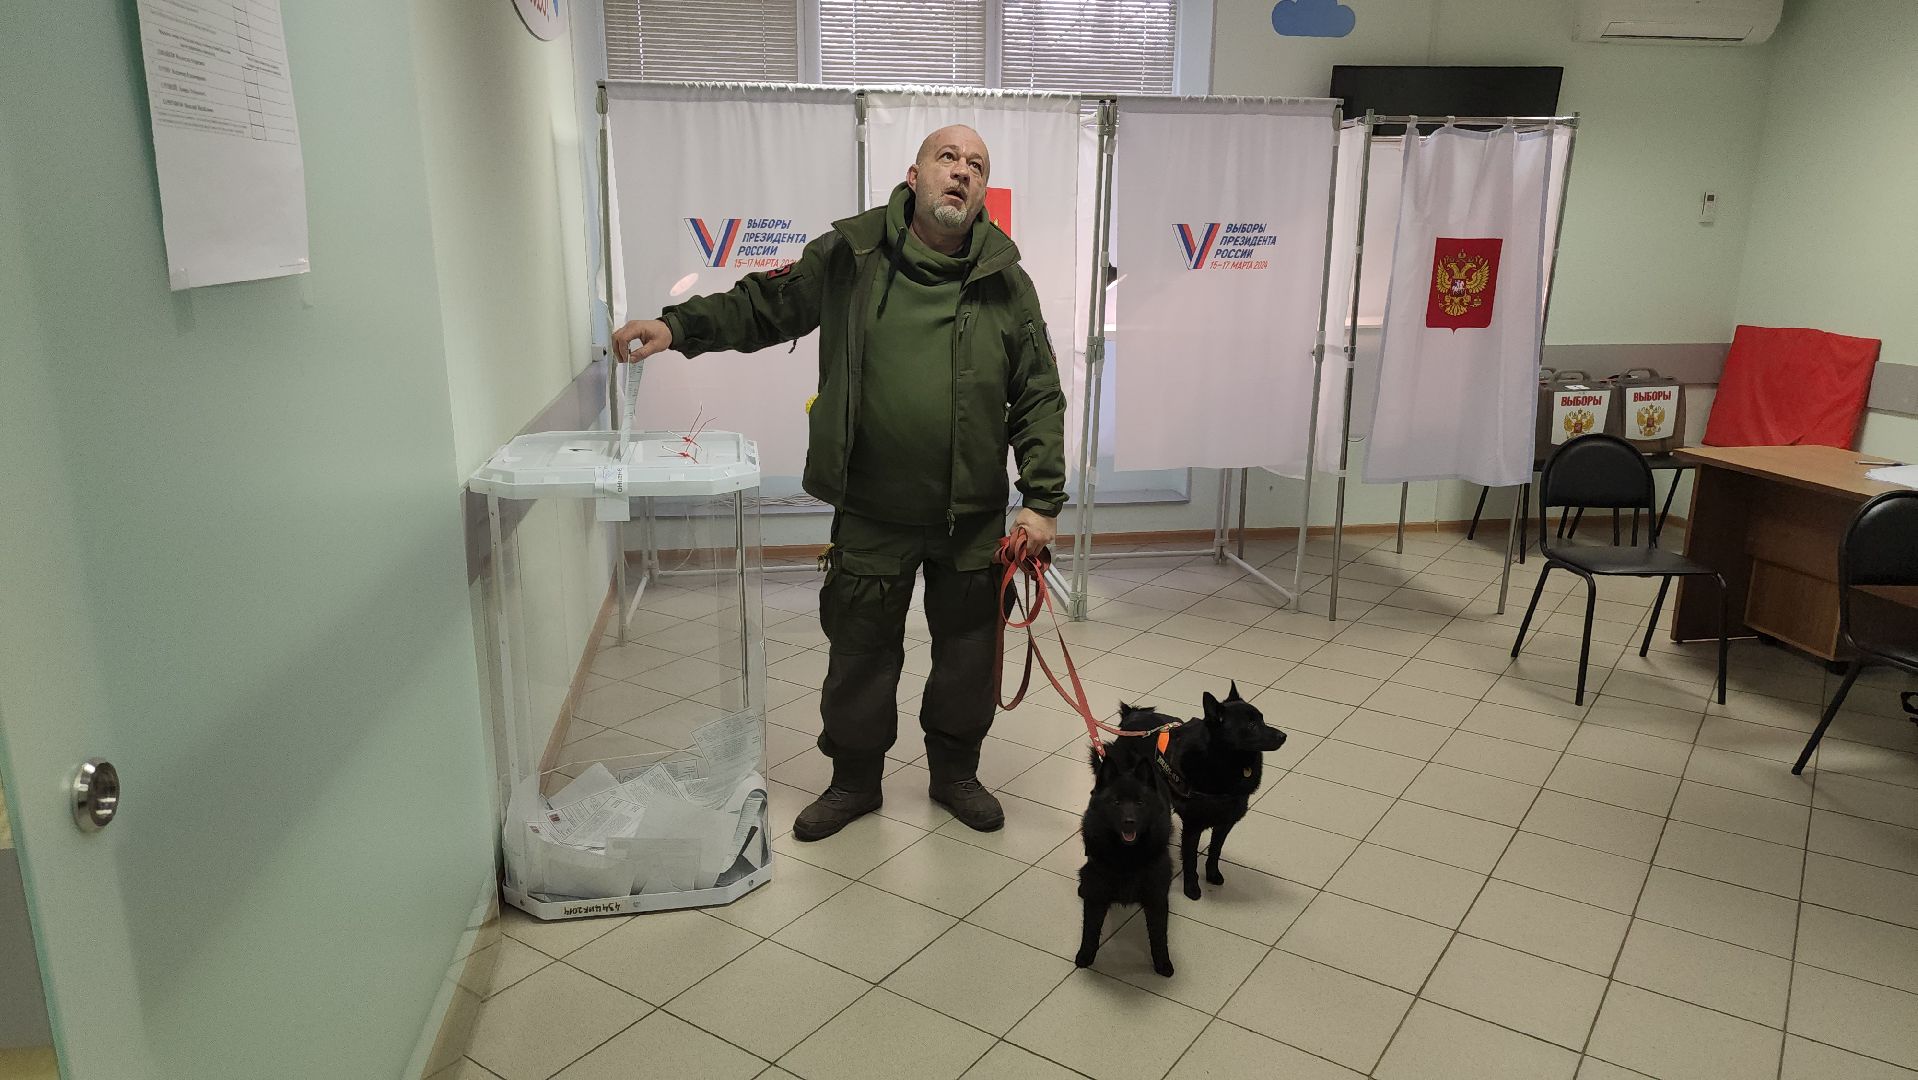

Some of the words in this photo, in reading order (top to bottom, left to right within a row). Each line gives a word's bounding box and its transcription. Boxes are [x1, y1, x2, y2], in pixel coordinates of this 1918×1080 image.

[746, 218, 792, 230] ВЫБОРЫ
[1225, 223, 1267, 234] ВЫБОРЫ
[741, 232, 807, 244] ПРЕЗИДЕНТА
[1219, 235, 1278, 246] ПРЕЗИДЕНТА
[737, 245, 778, 256] РОССИИ
[1214, 248, 1254, 259] РОССИИ
[753, 258, 779, 268] МАРТА
[1231, 260, 1253, 270] МАРТА
[1253, 260, 1268, 270] 2024
[1560, 395, 1603, 407] ВЫБОРЫ
[1632, 390, 1672, 403] ВЫБОРЫ
